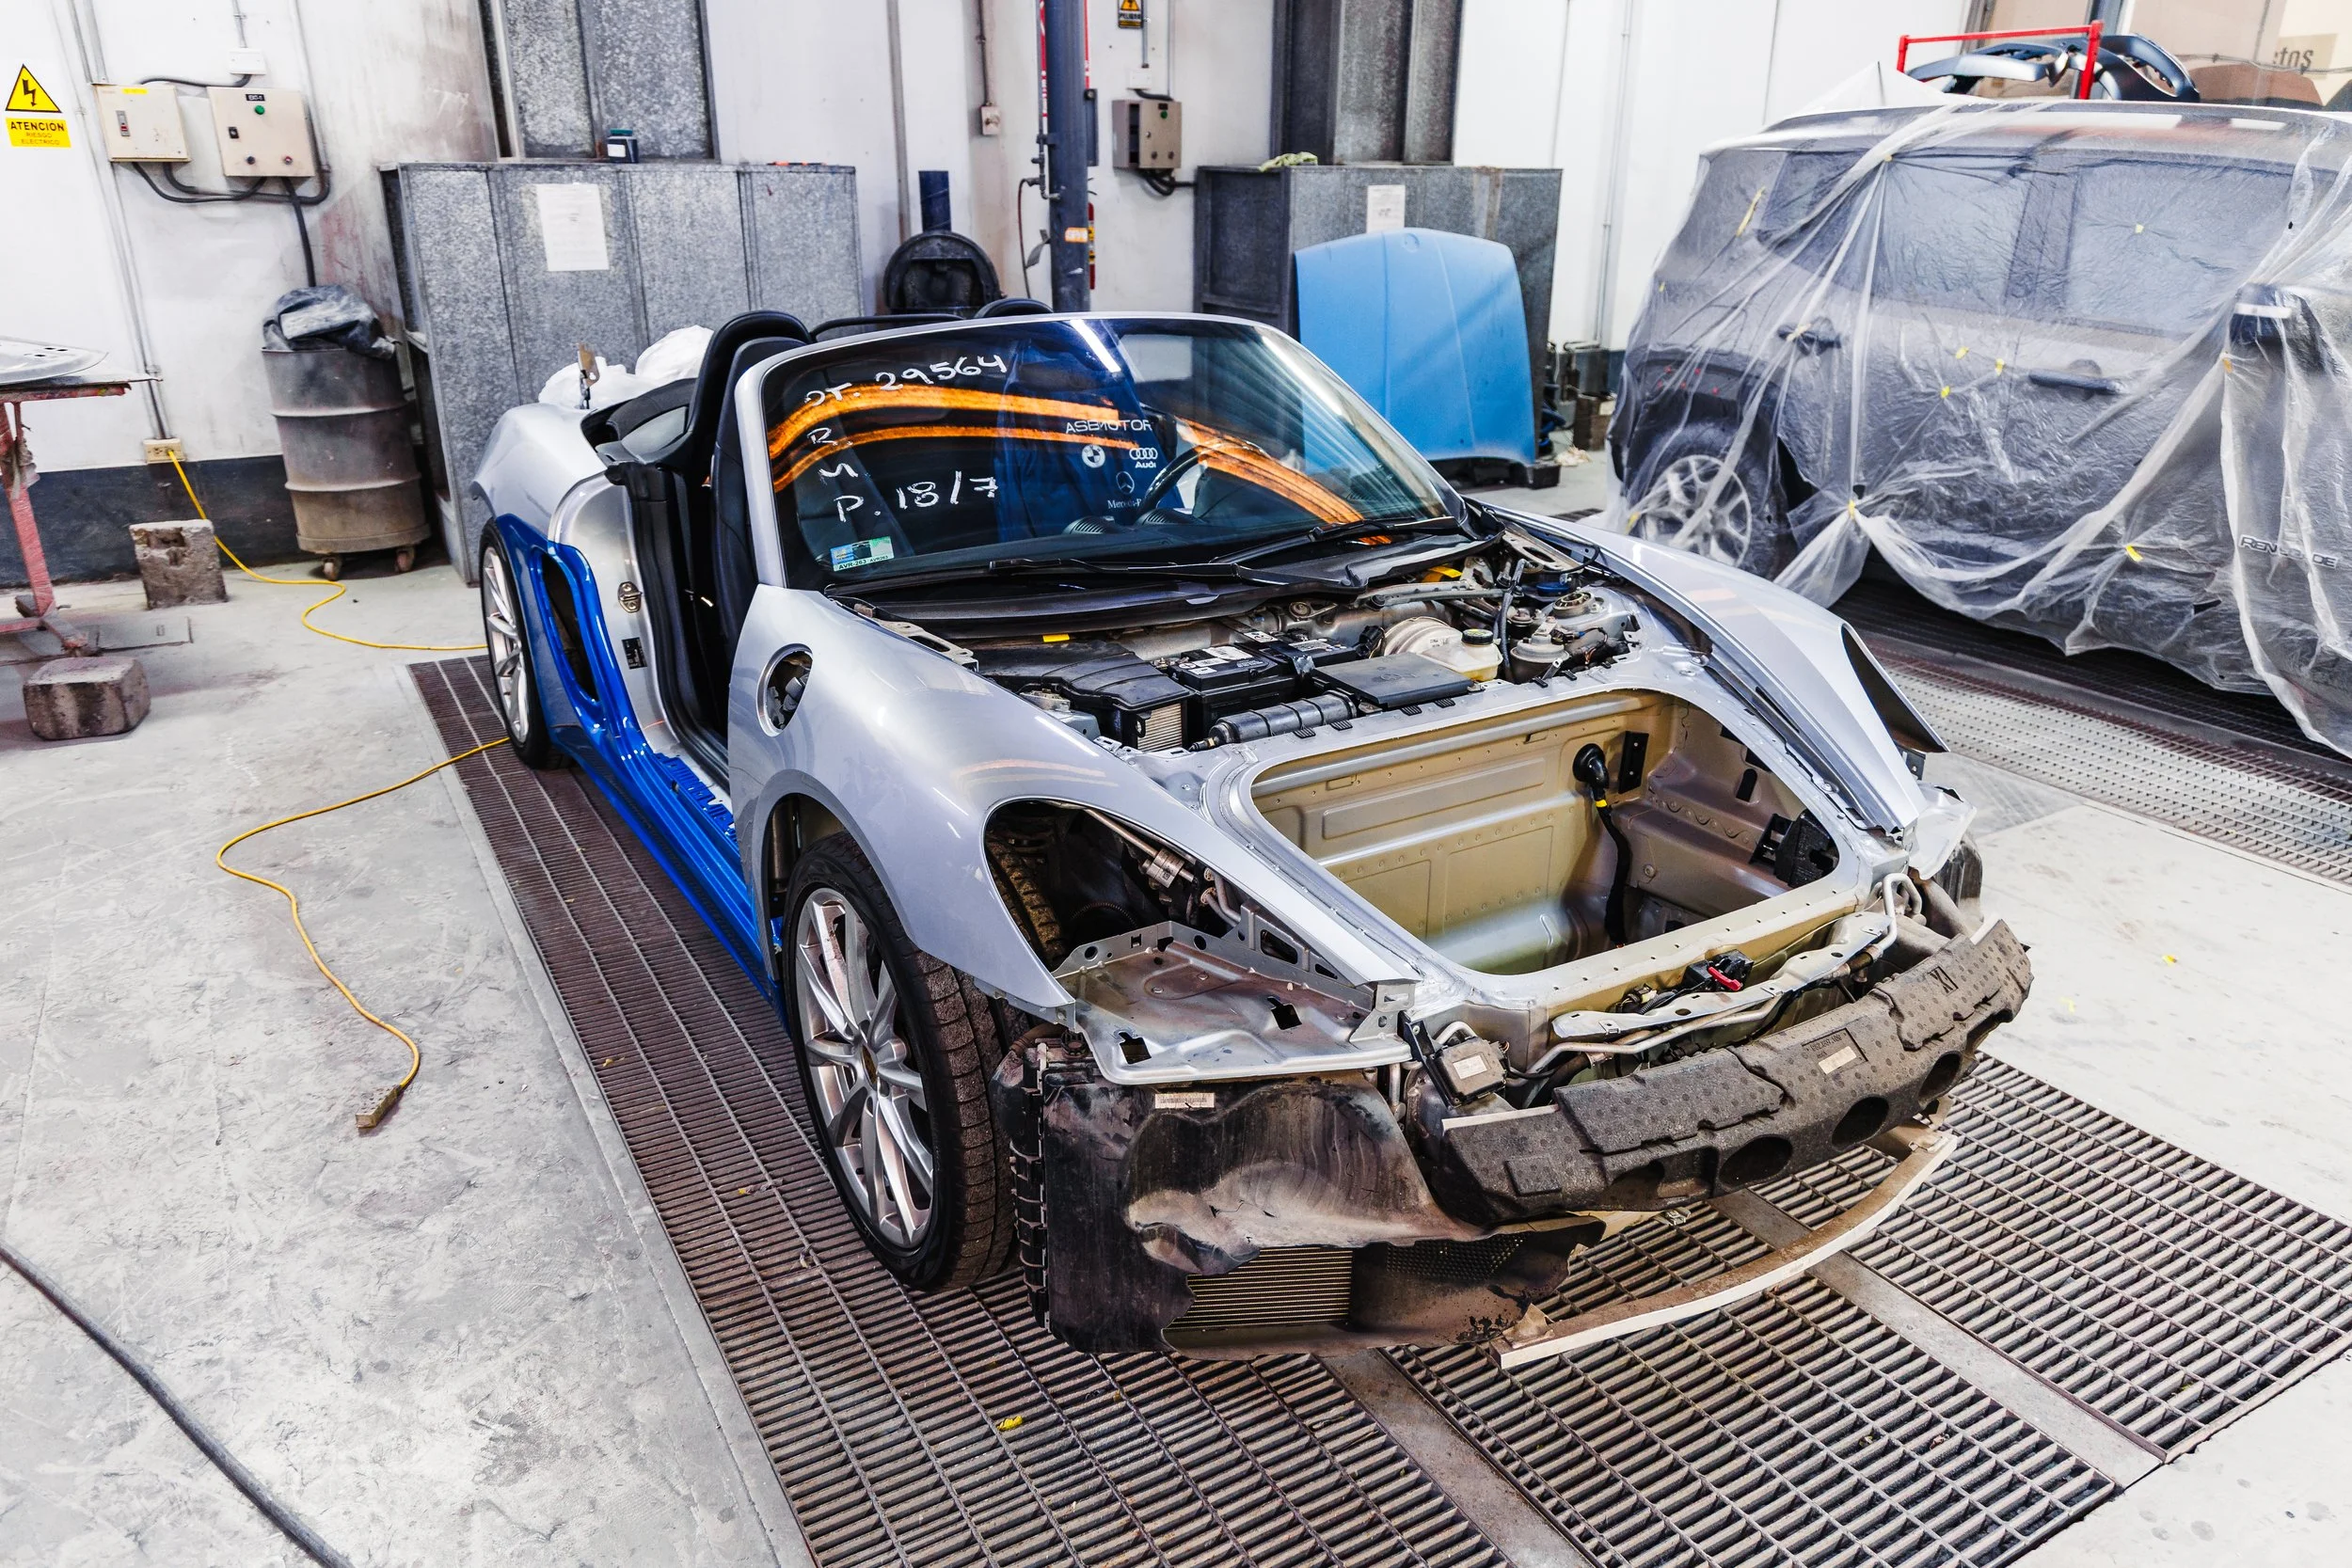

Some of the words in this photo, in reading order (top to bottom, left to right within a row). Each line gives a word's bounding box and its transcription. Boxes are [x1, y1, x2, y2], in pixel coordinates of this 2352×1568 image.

[875, 354, 1008, 391] 29564
[897, 470, 999, 510] 18/7
[2240, 534, 2338, 569] RENEGDE
